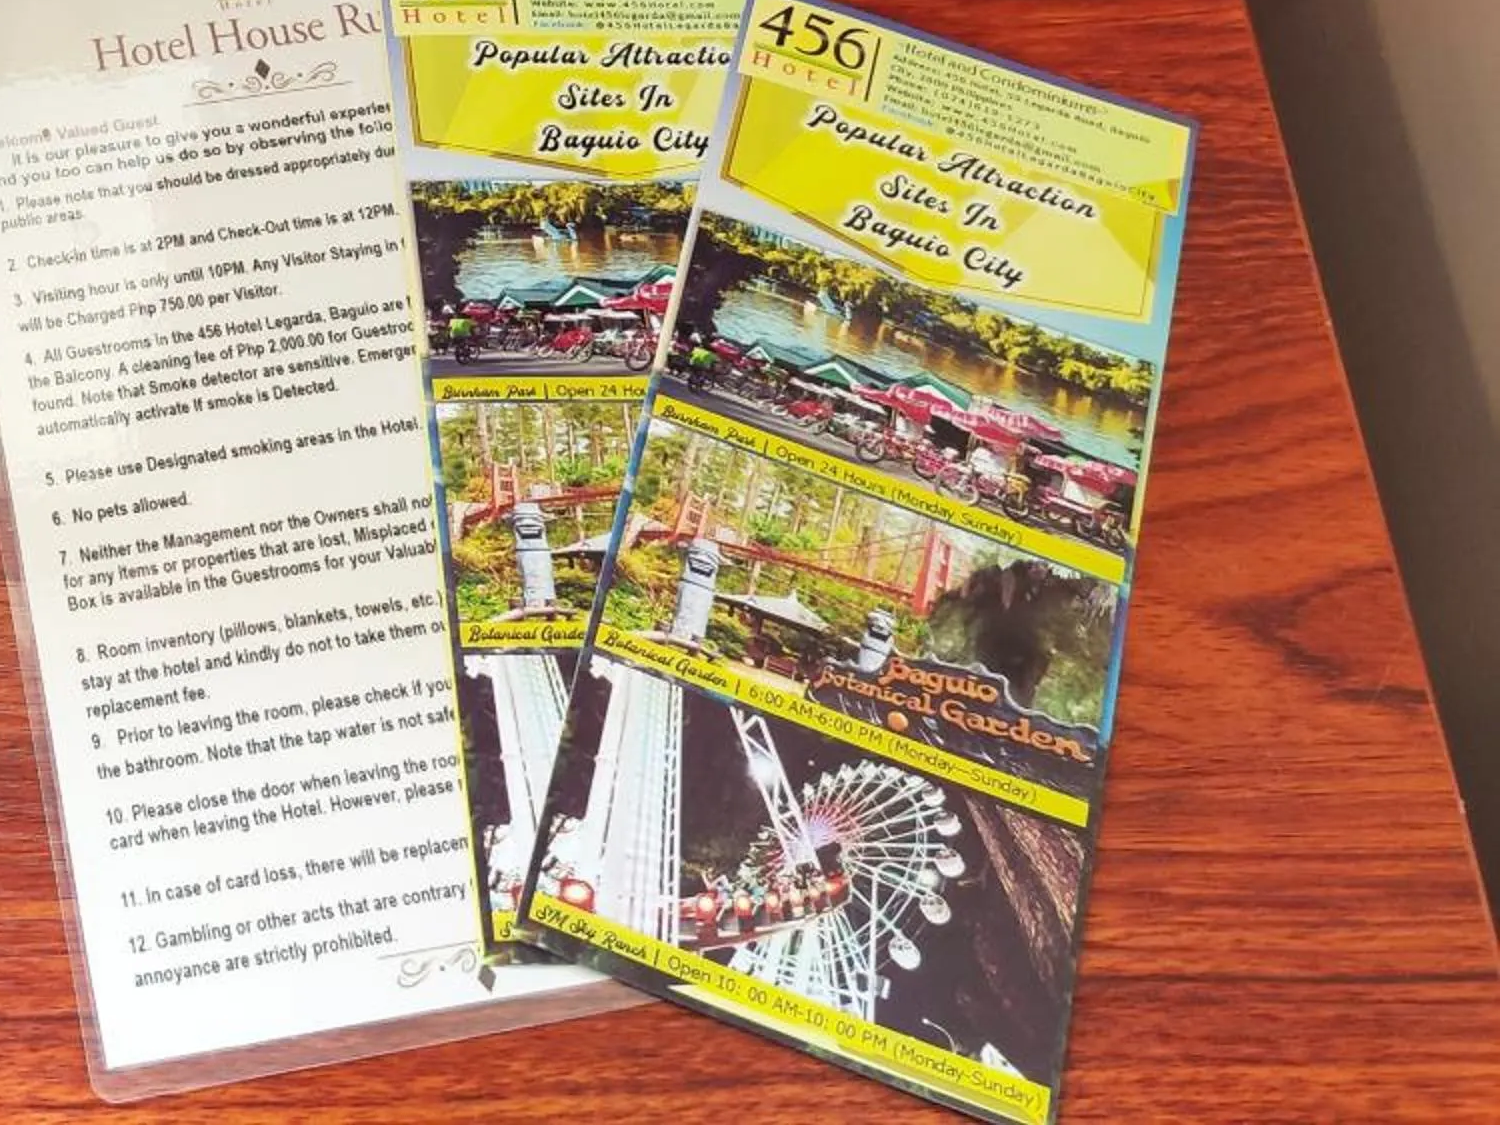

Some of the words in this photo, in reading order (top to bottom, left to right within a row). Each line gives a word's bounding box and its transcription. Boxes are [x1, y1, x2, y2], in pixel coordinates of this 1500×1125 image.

[91, 24, 197, 72] Hotel
[208, 16, 326, 56] House
[403, 7, 508, 25] Hotel
[760, 5, 869, 71] 456
[473, 40, 589, 68] Popular
[752, 48, 862, 97] Hotel
[948, 57, 975, 77] and
[558, 83, 626, 110] Sites
[638, 85, 674, 112] In
[539, 125, 641, 159] Baguio
[654, 127, 709, 156] City
[806, 103, 926, 163] Popular
[937, 152, 1096, 219] Attraction
[880, 174, 949, 216] Sites
[964, 203, 1000, 231] In
[25, 246, 87, 269] Check-in
[89, 245, 121, 260] time
[122, 241, 137, 255] is
[138, 238, 153, 253] at
[154, 232, 186, 251] 2PM
[188, 227, 215, 246] and
[216, 217, 291, 242] Check-Out
[290, 215, 323, 230] time
[324, 211, 339, 226] is
[341, 209, 355, 224] at
[843, 203, 950, 257] Baguio
[964, 246, 1024, 289] City
[506, 385, 537, 398] Park
[556, 385, 595, 401] Open
[600, 386, 618, 397] 24
[64, 465, 113, 484] Please
[116, 461, 143, 476] use
[144, 443, 228, 472] Designated
[229, 437, 293, 458] smoking
[294, 431, 335, 449] areas
[336, 426, 353, 442] in
[353, 423, 378, 440] the
[660, 404, 719, 435] Burnham
[723, 426, 756, 449] Park
[775, 445, 815, 471] Open
[820, 461, 839, 477] 24
[843, 469, 886, 497] Hours
[70, 507, 94, 524] No
[96, 502, 129, 523] pets
[468, 625, 537, 642] Botanical
[603, 630, 673, 666] Botanical
[675, 656, 728, 688] Garden
[749, 686, 784, 707] 6:00
[857, 726, 883, 745] PM
[878, 655, 1000, 704] Baguio
[814, 665, 936, 716] Botanical
[940, 699, 1093, 764] Garden
[144, 886, 161, 904] In
[164, 882, 202, 901] case
[204, 874, 221, 894] of
[224, 868, 261, 890] card
[262, 865, 302, 884] loss,
[303, 857, 345, 876] there
[348, 847, 376, 869] will
[378, 847, 399, 864] be
[154, 922, 233, 949] Gambling
[234, 919, 252, 936] or
[255, 911, 297, 932] other
[301, 904, 335, 924] acts
[336, 897, 370, 917] that
[372, 894, 398, 911] are
[401, 882, 465, 906] contrary
[134, 959, 221, 988] annoyance
[224, 954, 250, 972] are
[253, 941, 307, 966] strictly
[536, 905, 568, 929] SM
[569, 918, 596, 942] Sky
[602, 930, 648, 960] Ranch
[668, 954, 711, 986] Open
[747, 986, 769, 1006] 00
[835, 1019, 858, 1039] 00
[863, 1028, 888, 1052] PM
